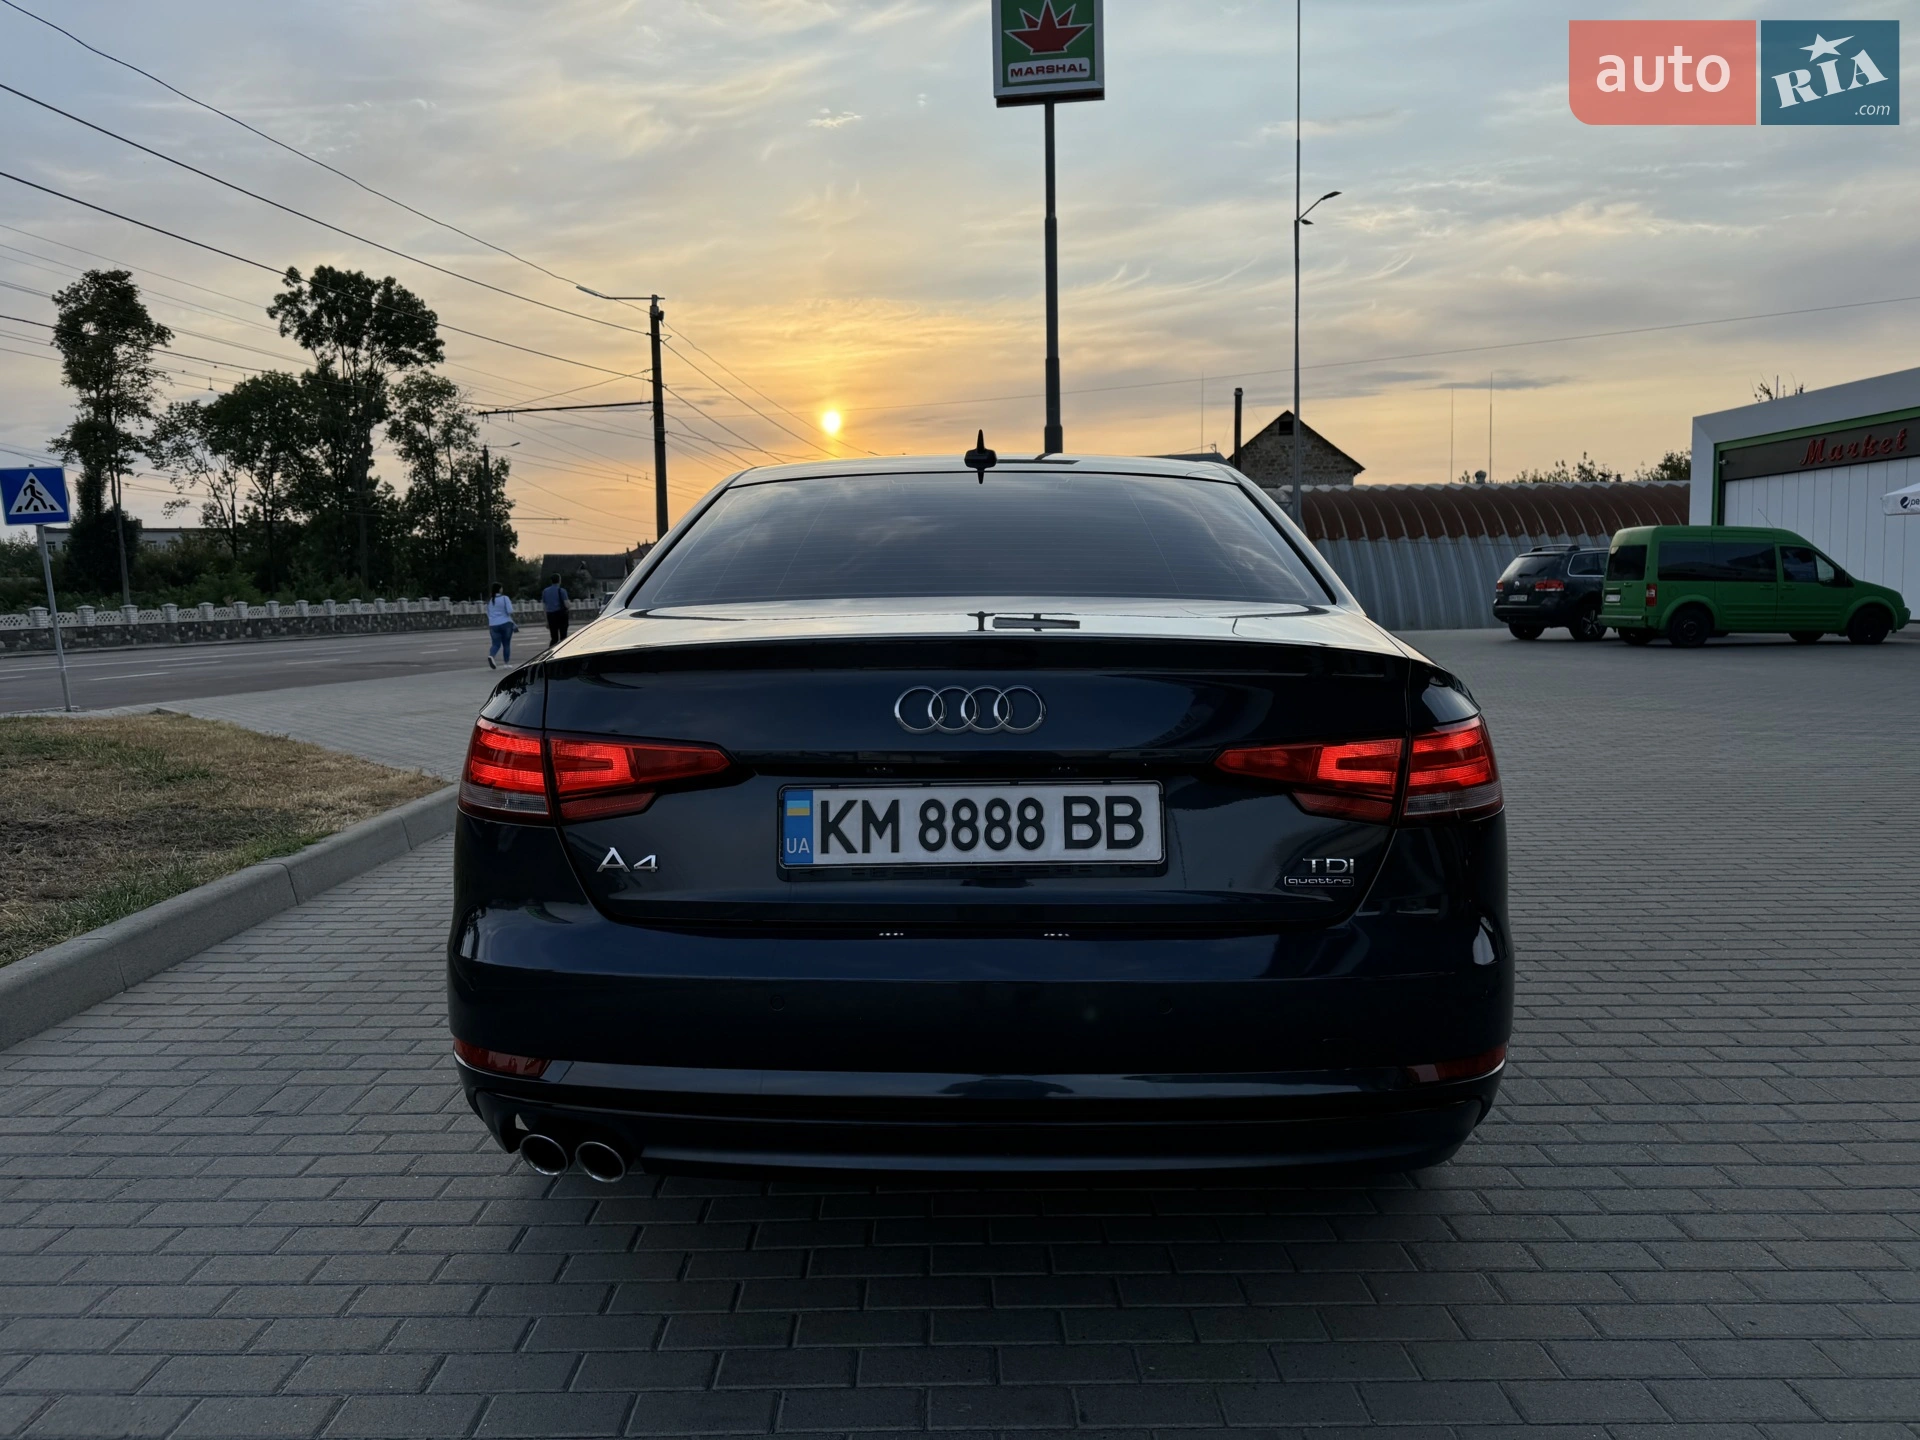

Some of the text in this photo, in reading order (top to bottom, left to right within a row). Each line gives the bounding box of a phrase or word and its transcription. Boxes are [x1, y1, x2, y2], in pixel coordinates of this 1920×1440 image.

[1010, 63, 1088, 78] MARSHAL
[1801, 428, 1907, 465] Market
[786, 795, 1144, 854] UA KM 8888 BB
[596, 846, 658, 873] A4
[1302, 858, 1354, 873] TDI
